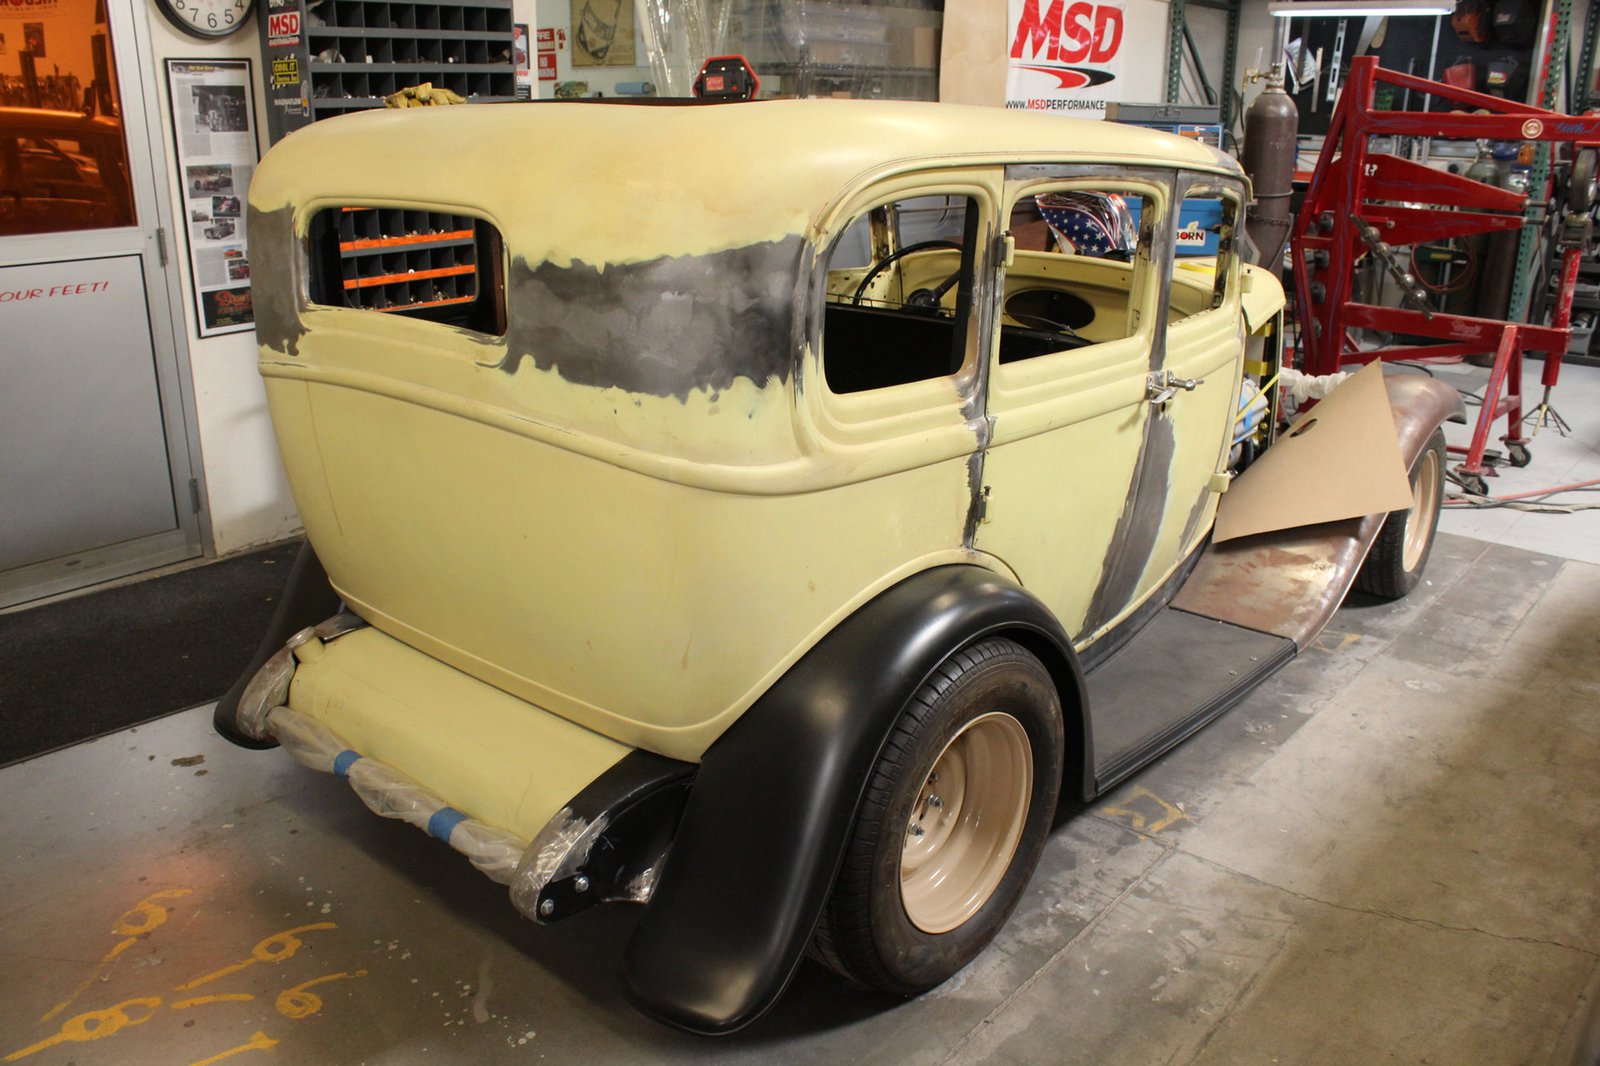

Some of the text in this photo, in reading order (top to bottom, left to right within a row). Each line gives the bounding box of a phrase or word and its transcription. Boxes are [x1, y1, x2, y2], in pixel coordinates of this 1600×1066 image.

[175, 0, 185, 10] 8
[189, 8, 199, 22] 7
[207, 13, 217, 28] 6
[224, 9, 234, 24] 5
[269, 14, 299, 36] MSD
[1010, 0, 1124, 64] MSD
[49, 281, 108, 297] FEET!
